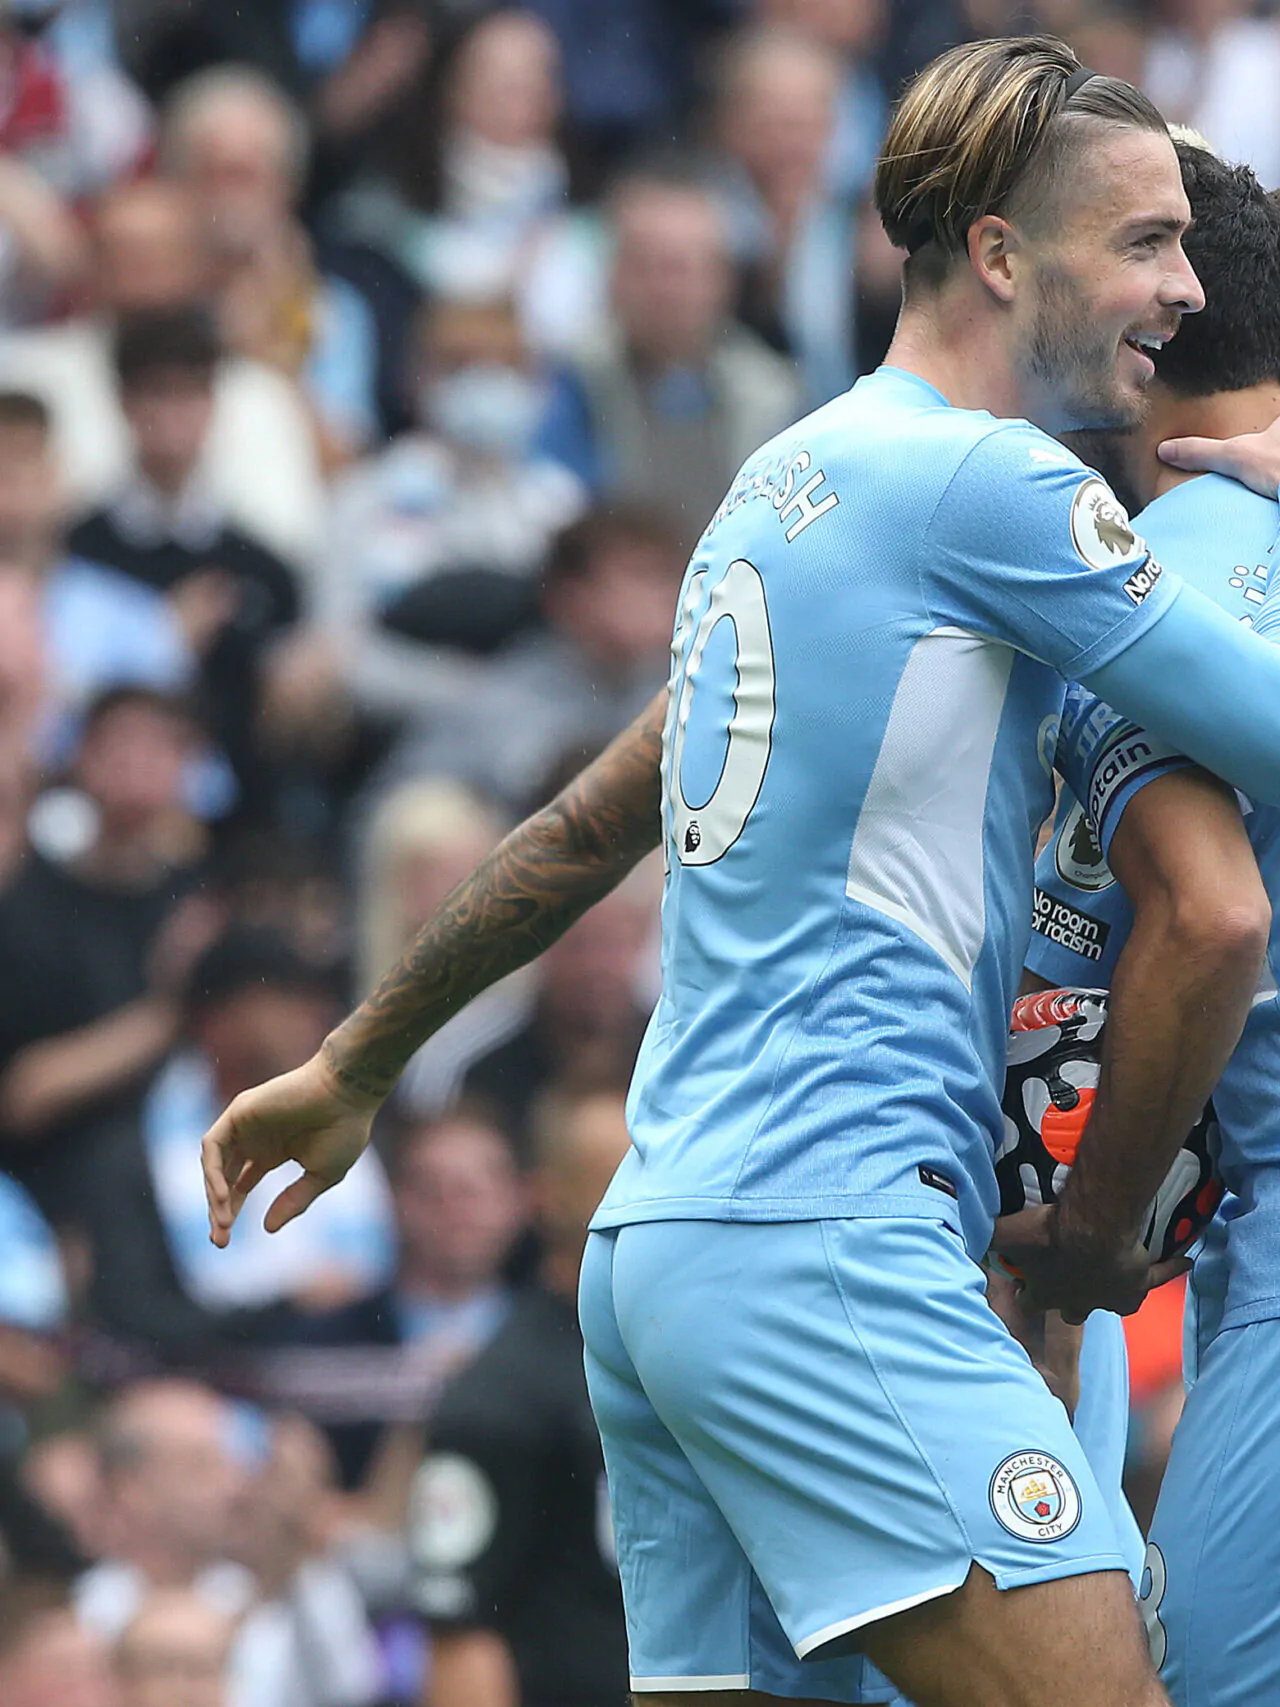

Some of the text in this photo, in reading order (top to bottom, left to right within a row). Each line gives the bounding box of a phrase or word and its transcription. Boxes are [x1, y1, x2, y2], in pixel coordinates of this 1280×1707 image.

[1123, 572, 1151, 602] No
[1143, 557, 1162, 582] ro
[1091, 742, 1152, 828] ptain
[1031, 911, 1102, 960] or racism
[1033, 887, 1099, 940] No room
[997, 1456, 1064, 1494] MANCHESTER
[1037, 1523, 1063, 1537] CITY
